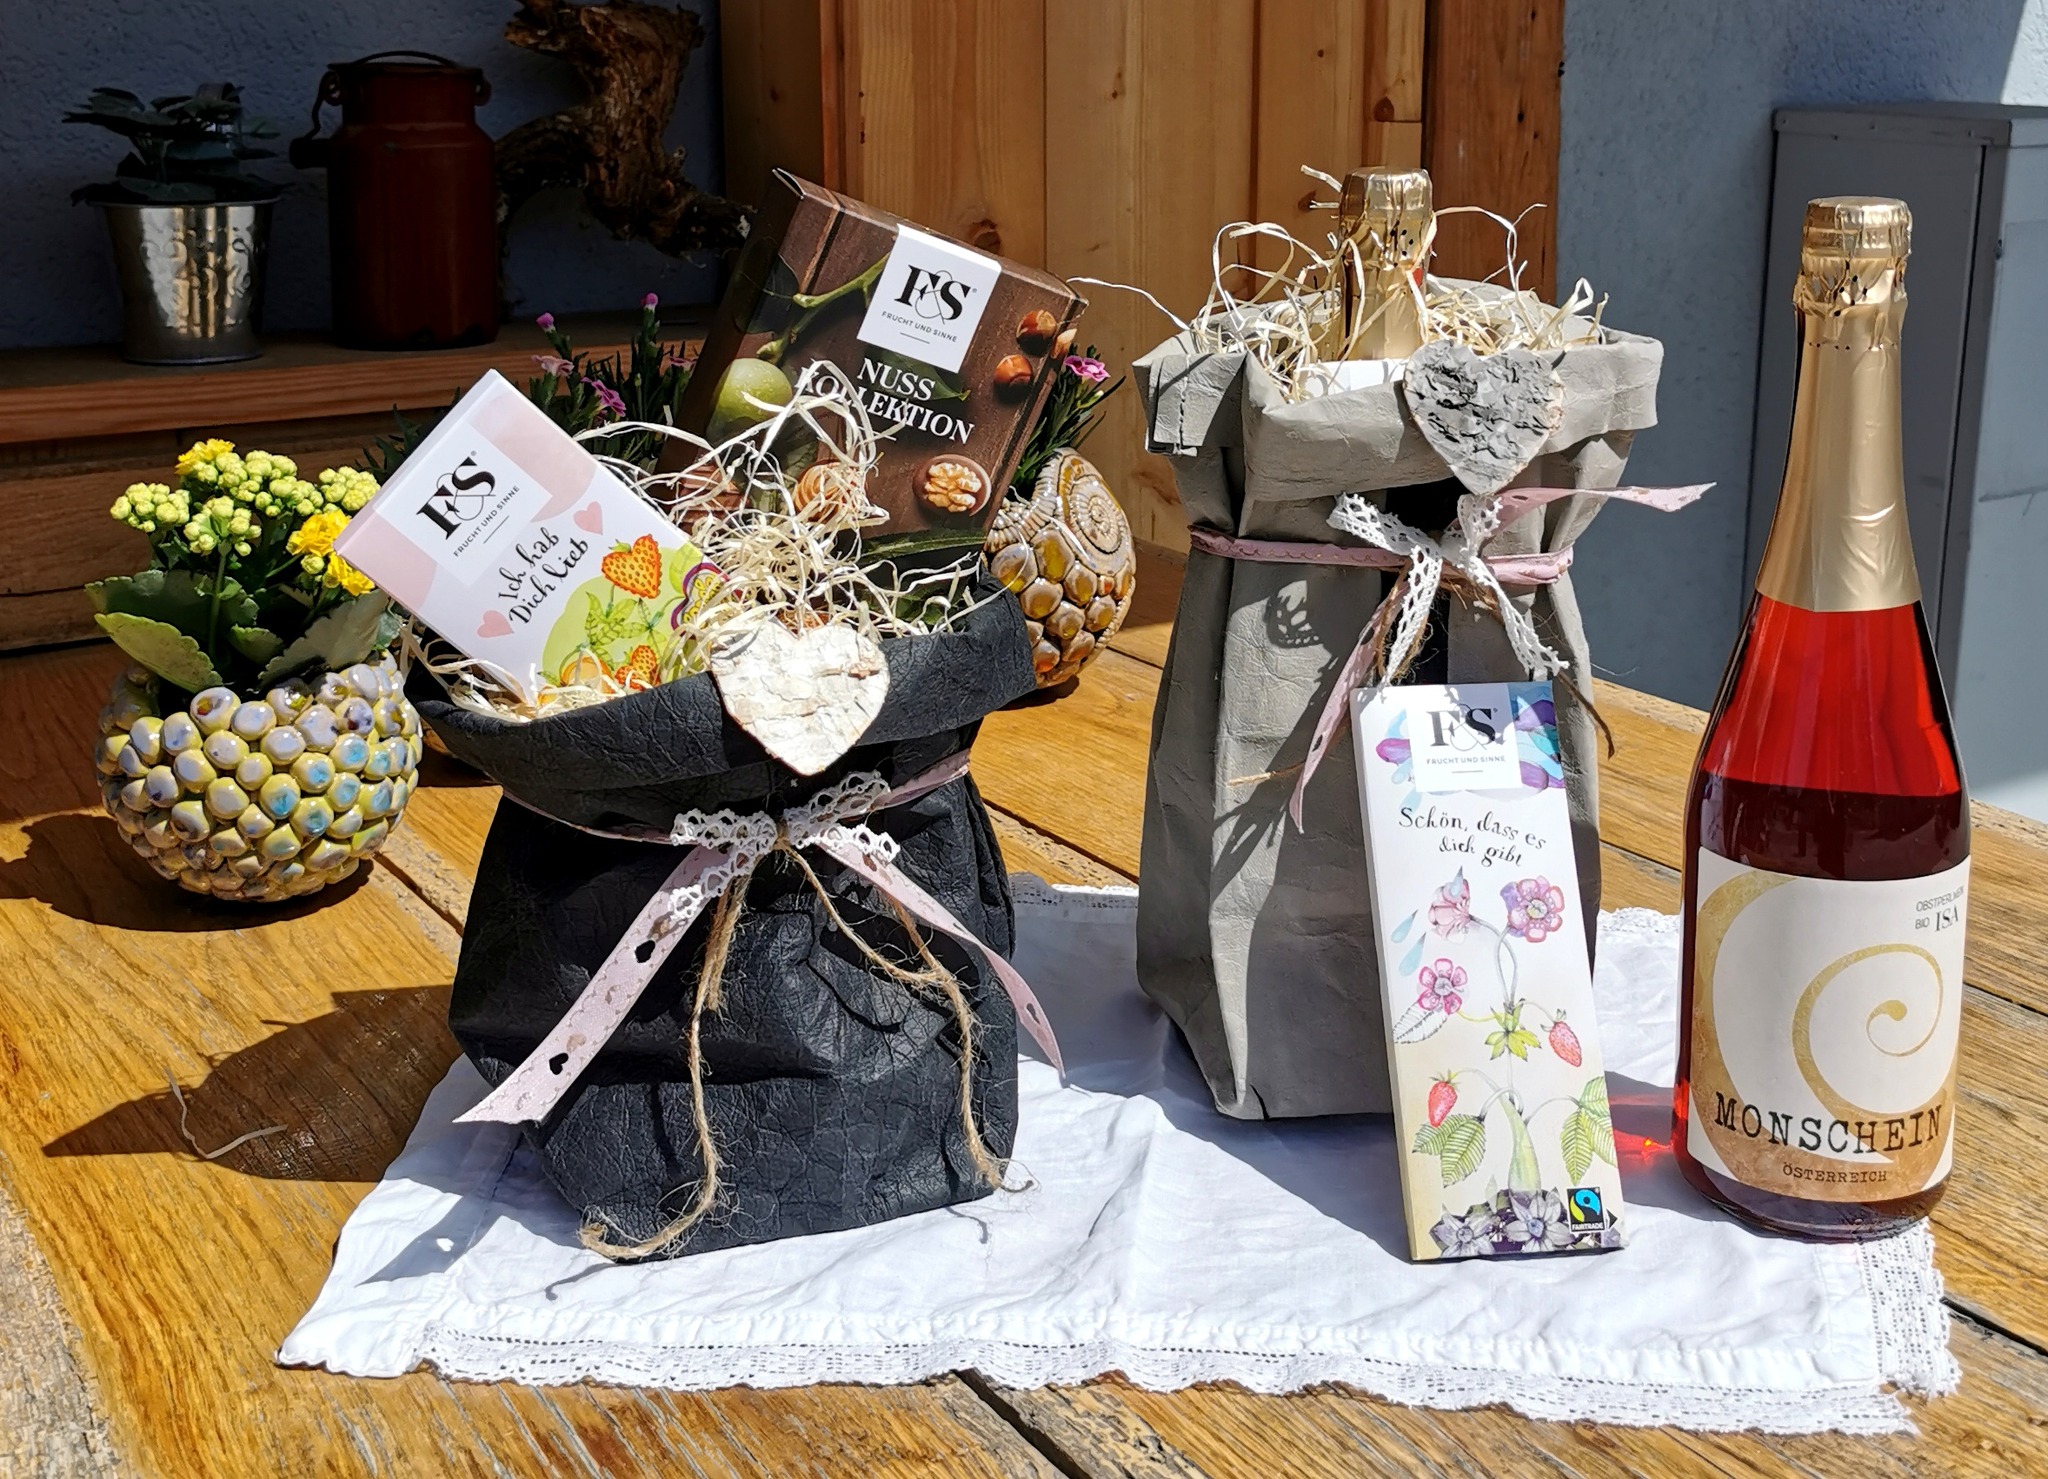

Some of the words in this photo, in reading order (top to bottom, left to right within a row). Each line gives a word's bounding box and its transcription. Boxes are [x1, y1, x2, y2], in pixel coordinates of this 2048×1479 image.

[881, 310, 914, 326] FRUCHT
[915, 322, 932, 333] UND
[933, 328, 957, 342] SINNE
[857, 357, 936, 402] NUSS
[453, 526, 482, 557] FRUCHT
[481, 509, 498, 527] UND
[497, 485, 520, 510] SINNE
[498, 566, 527, 600] Ich
[515, 527, 560, 568] hab
[509, 574, 556, 623] Dich
[542, 537, 588, 584] lieb
[1426, 757, 1459, 765] FRUCHT
[1398, 805, 1468, 832] Schön,
[1477, 811, 1519, 841] dass
[1525, 832, 1547, 849] es
[1438, 835, 1475, 854] dich
[1481, 844, 1522, 867] gibt
[1914, 917, 1931, 930] BIO
[1714, 1091, 1942, 1154] MONSCHEIN
[1783, 1162, 1888, 1183] ÖSTERREICH
[1571, 1222, 1604, 1230] FAIRTRADE
